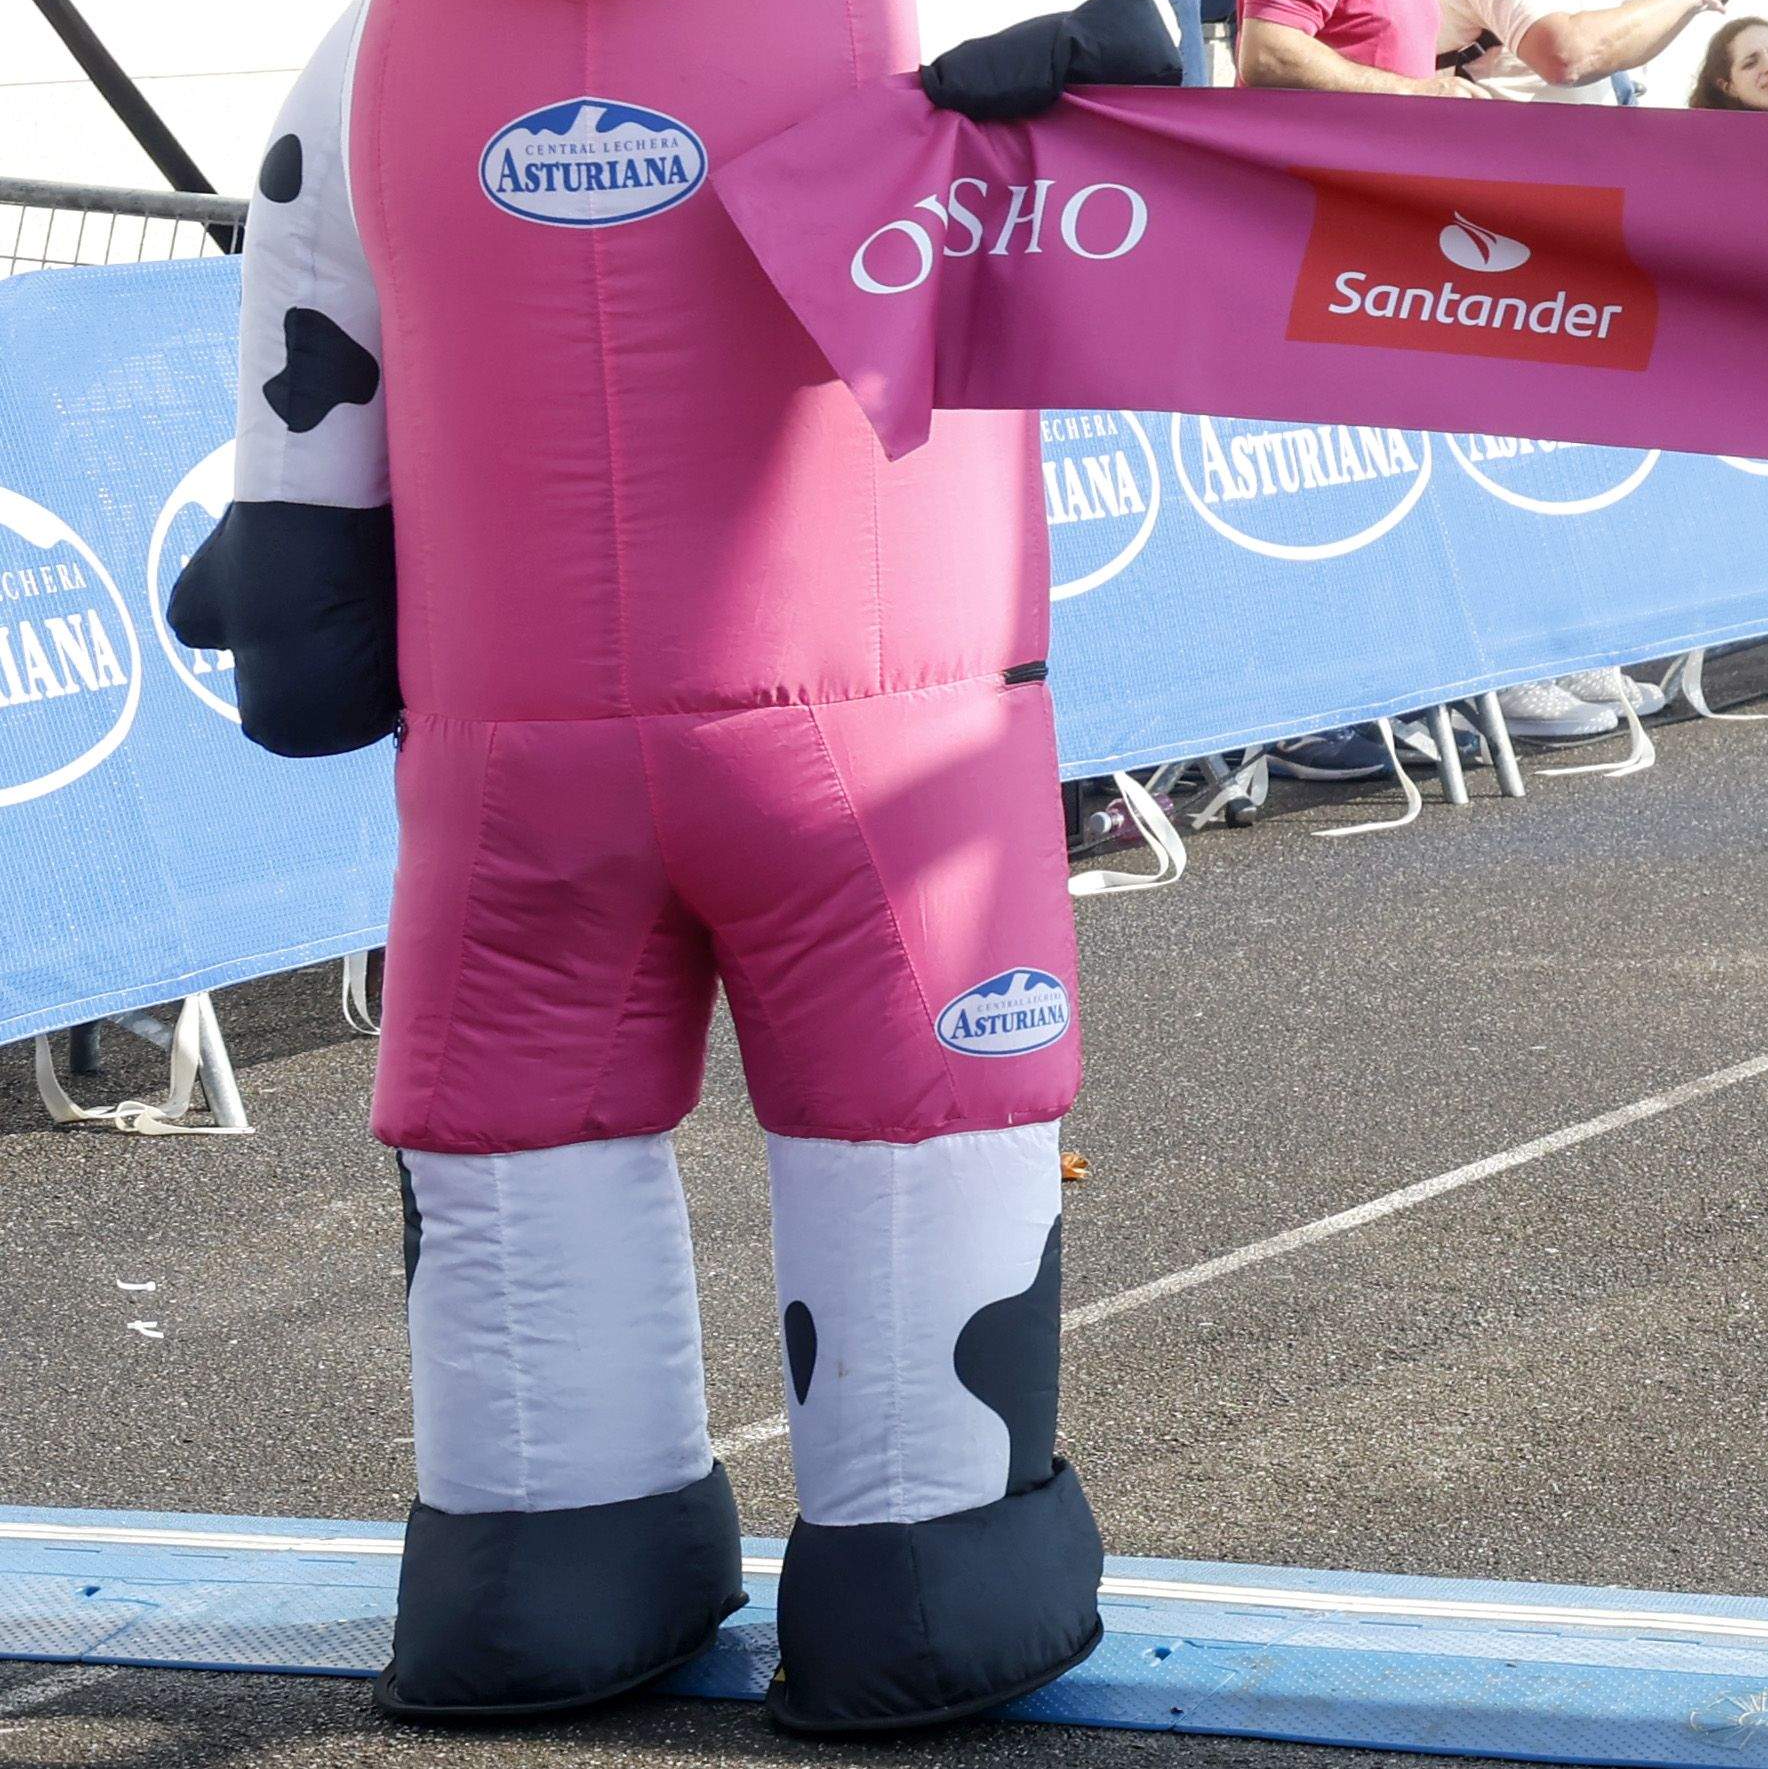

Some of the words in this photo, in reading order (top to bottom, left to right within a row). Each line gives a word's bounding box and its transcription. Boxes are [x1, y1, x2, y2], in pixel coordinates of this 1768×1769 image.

[525, 143, 596, 155] CENTRAL
[603, 137, 680, 153] LECHERA
[496, 148, 689, 193] ASTURIANA
[1329, 270, 1623, 340] Santander
[1041, 414, 1119, 443] ECHERA
[1203, 414, 1418, 504] ASTURIANA
[949, 1004, 1066, 1041] ASTURIANA
